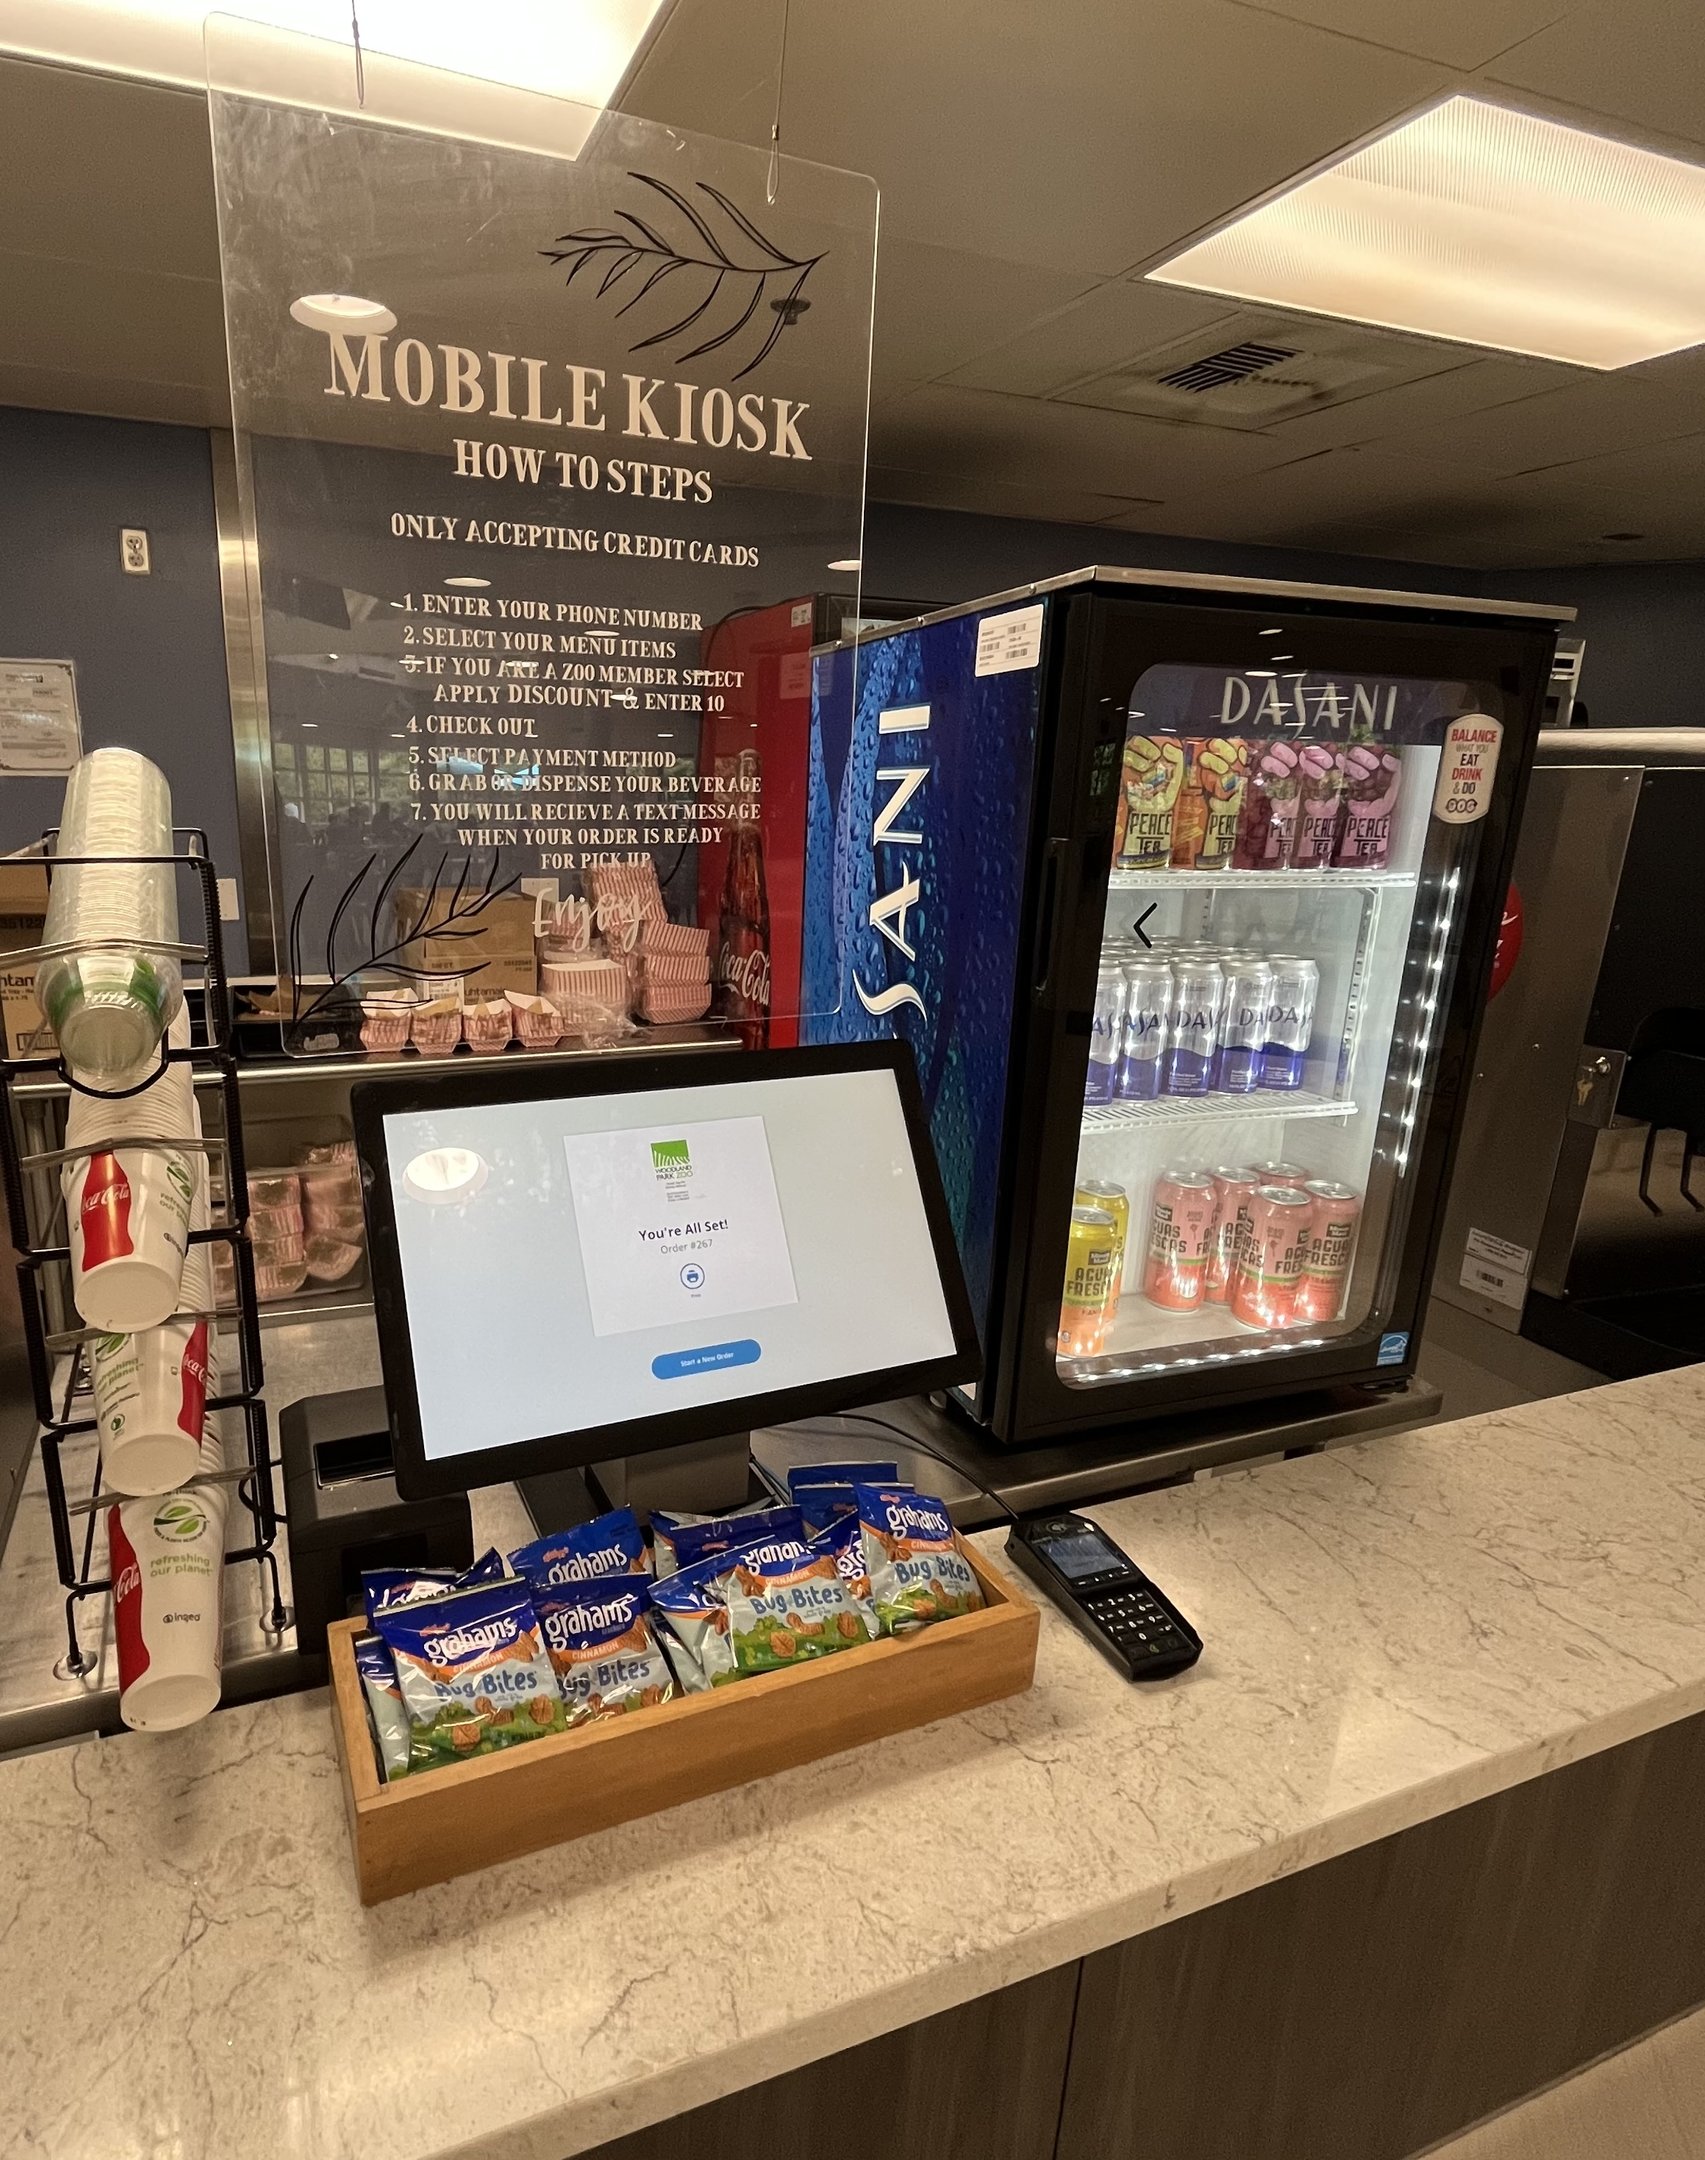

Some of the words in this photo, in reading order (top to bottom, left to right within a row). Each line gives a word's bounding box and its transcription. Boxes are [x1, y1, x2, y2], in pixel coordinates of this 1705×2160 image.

[324, 331, 606, 431] MOBILE
[621, 374, 813, 460] KIOSK
[452, 439, 546, 484] HOW
[556, 452, 599, 491] TO
[607, 460, 713, 504] STEPS
[390, 512, 458, 541] ONLY
[465, 518, 599, 553] ACCEPTING
[603, 533, 685, 561] CREDIT
[689, 541, 759, 568] CARDS
[422, 594, 492, 617] ENTER
[497, 599, 551, 621] YOUR
[556, 605, 620, 626] PHONE
[623, 608, 704, 632] NUMBER
[422, 626, 497, 649] SELECT
[502, 631, 555, 653] YOUR
[559, 635, 616, 656] MENU
[620, 639, 677, 660] ITEMS
[425, 656, 446, 674] IF
[450, 657, 491, 676] YOU
[497, 661, 540, 679] ARE
[542, 662, 558, 680] A
[562, 663, 596, 682] ZOO
[598, 665, 678, 686] MEMBER
[682, 668, 744, 689] SELECT
[434, 684, 499, 704] APPLY
[507, 683, 613, 708] DISCOUNT
[644, 692, 702, 711] ENTER
[707, 695, 725, 712] 10
[1220, 670, 1398, 740] DASANI
[426, 715, 494, 736] CHECK
[498, 717, 537, 737] OUT
[1451, 729, 1497, 743] BALANCE
[428, 746, 500, 766] SELECT
[504, 749, 599, 768] PAYMENT
[601, 750, 676, 769] METHOD
[1460, 753, 1480, 767] EAT
[428, 772, 487, 792] GRAB
[521, 775, 611, 793] DISPENSE
[615, 776, 663, 793] YOUR
[667, 776, 762, 794] BEVERAGE
[1452, 767, 1483, 781] DRINK
[1461, 782, 1476, 794] DO
[431, 803, 469, 821] YOU
[475, 803, 528, 821] WILL
[531, 803, 613, 821] RECIEVE
[616, 803, 630, 820] A
[633, 803, 679, 820] TEXT
[679, 803, 761, 820] MESSAGE
[1130, 813, 1172, 836] PEACE
[1347, 817, 1388, 838] PEACE
[458, 829, 518, 846] WHEN
[523, 828, 574, 846] YOUR
[578, 828, 639, 845] ORDER
[643, 827, 661, 844] IS
[663, 827, 723, 844] READY
[1354, 838, 1381, 856] TEA
[541, 852, 575, 870] FOR
[580, 852, 620, 869] PICK
[852, 704, 931, 1033] SANI
[532, 886, 645, 954] Enjoy
[638, 1225, 682, 1242] You're
[685, 1222, 702, 1236] All
[704, 1219, 729, 1233] Set!
[660, 1242, 688, 1255] Order
[690, 1238, 713, 1251] #267
[886, 1505, 948, 1540] grahams
[150, 1553, 210, 1568] refreshing
[150, 1565, 171, 1578] our
[548, 1544, 627, 1584] grahams
[895, 1561, 931, 1584] Bug
[936, 1556, 970, 1581] Bites
[751, 1595, 788, 1614] Bug
[791, 1586, 843, 1608] Bites
[545, 1600, 632, 1653] grahams
[424, 1617, 518, 1667] grahams
[572, 1641, 619, 1660] CINNAMON
[482, 1670, 537, 1694] Bites
[597, 1660, 650, 1686] Bites
